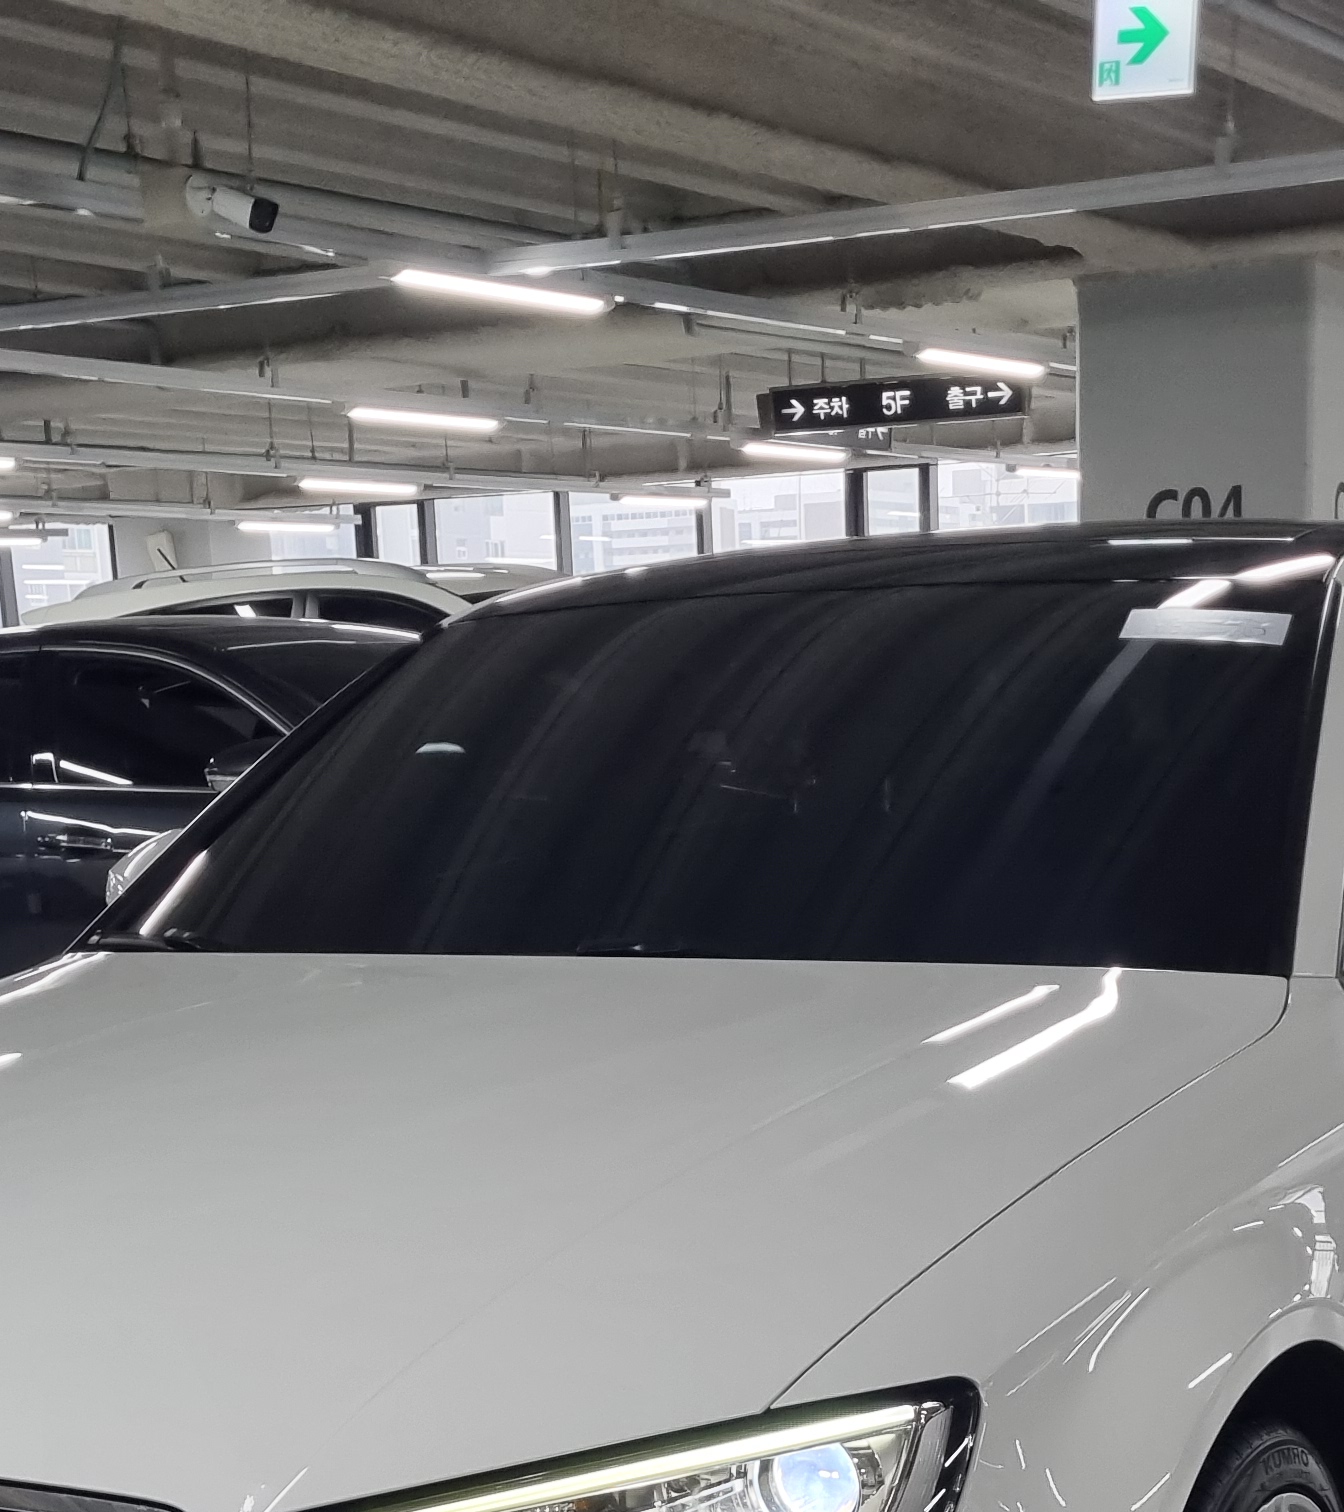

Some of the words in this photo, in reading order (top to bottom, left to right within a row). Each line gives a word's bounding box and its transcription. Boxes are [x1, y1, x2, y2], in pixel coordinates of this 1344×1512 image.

[812, 396, 849, 420] 주차
[881, 391, 911, 416] 5F
[946, 386, 984, 410] 출구
